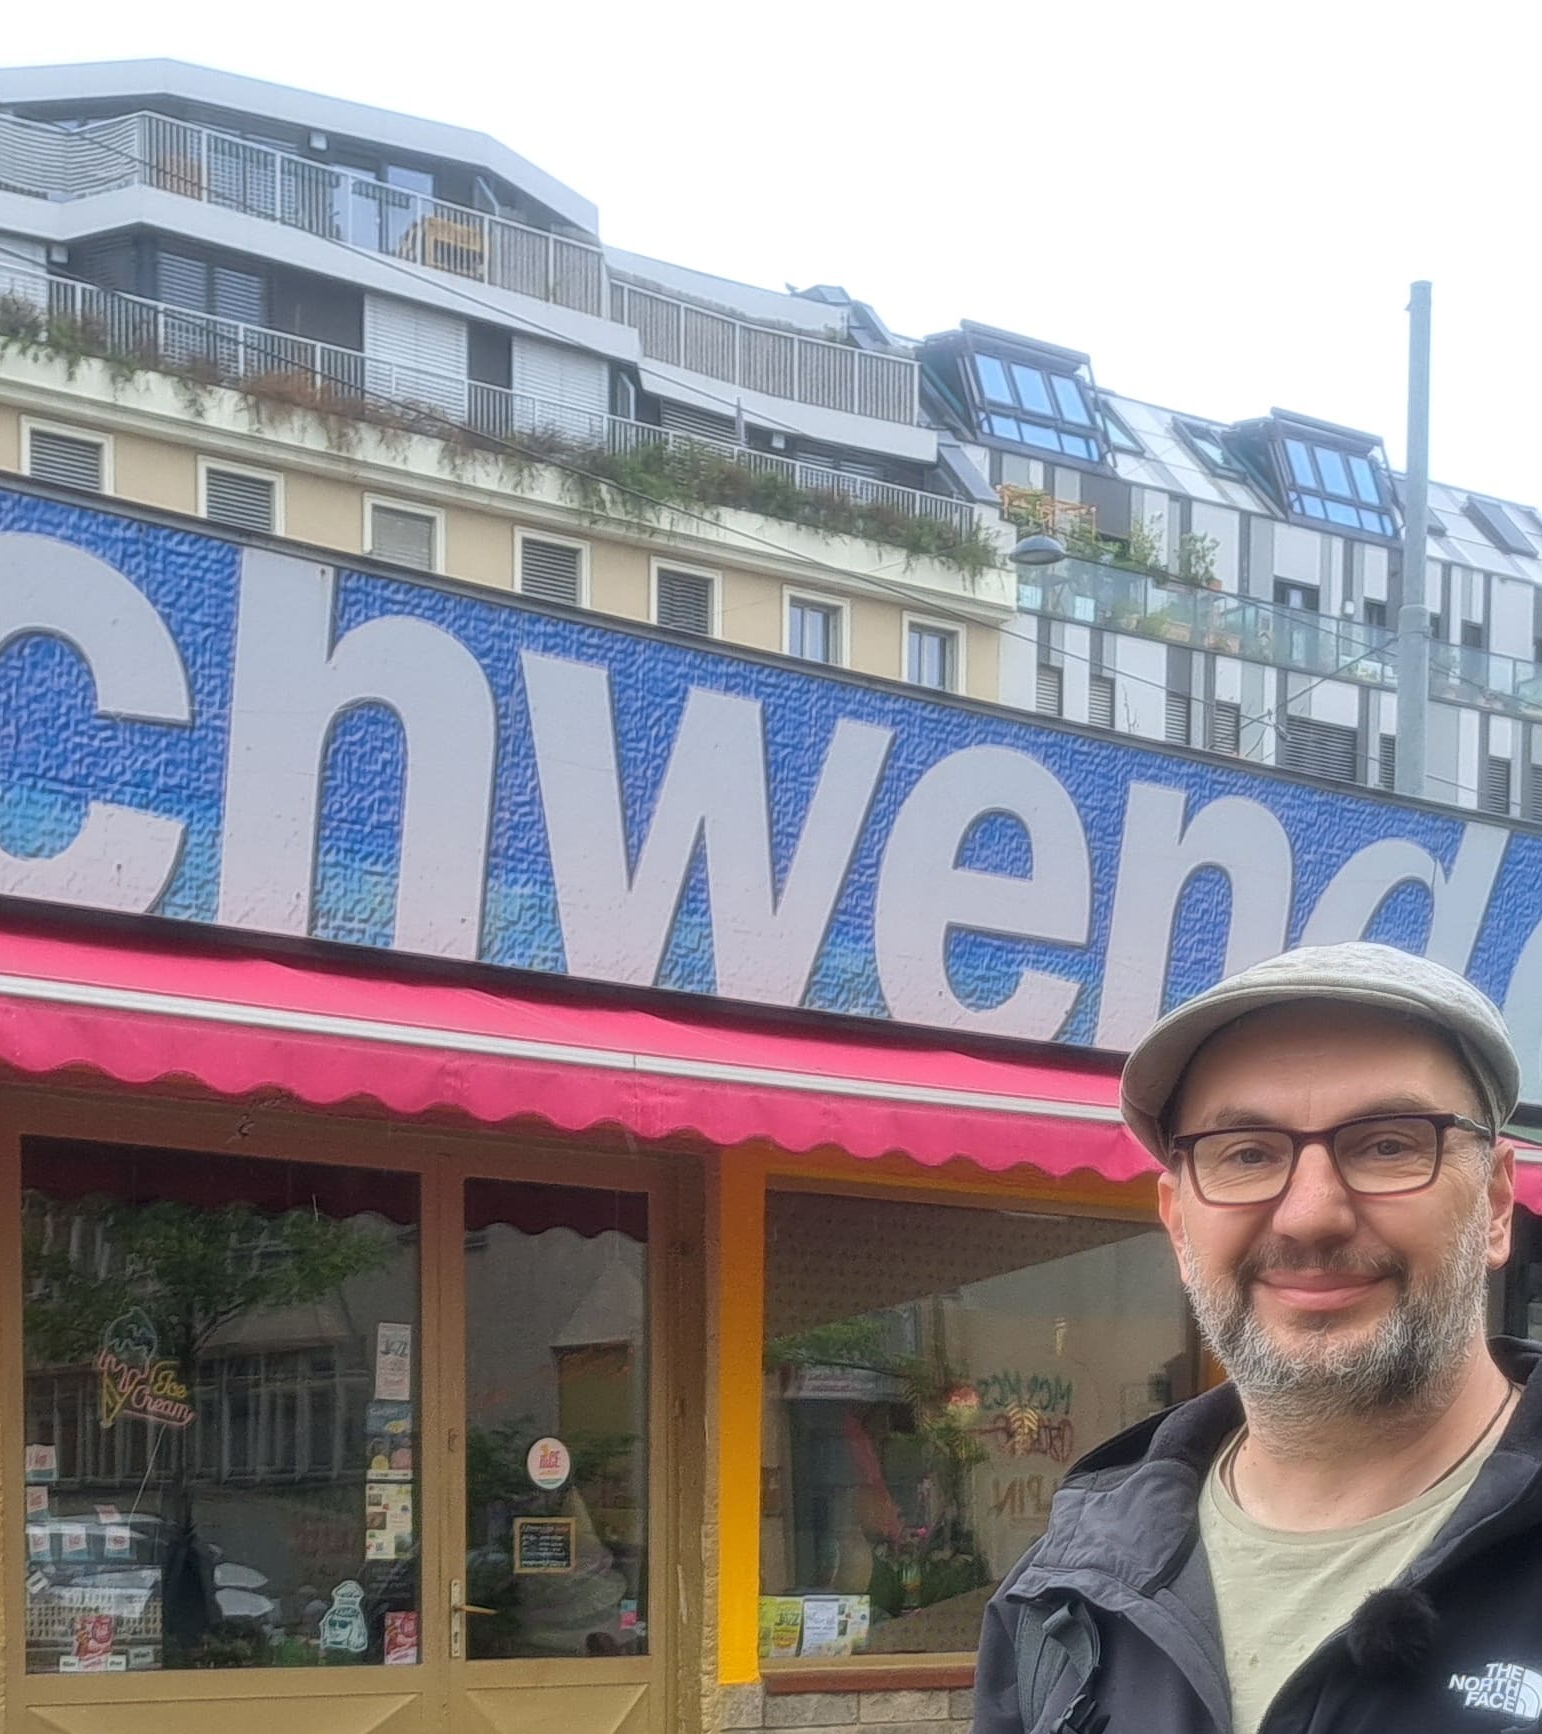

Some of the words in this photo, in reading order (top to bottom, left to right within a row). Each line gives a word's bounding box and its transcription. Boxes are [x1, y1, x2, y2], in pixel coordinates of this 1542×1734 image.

[130, 1384, 196, 1419] Cream
[1485, 1662, 1525, 1683] THE
[1447, 1673, 1521, 1698] NORTH
[1464, 1691, 1516, 1713] FACE
